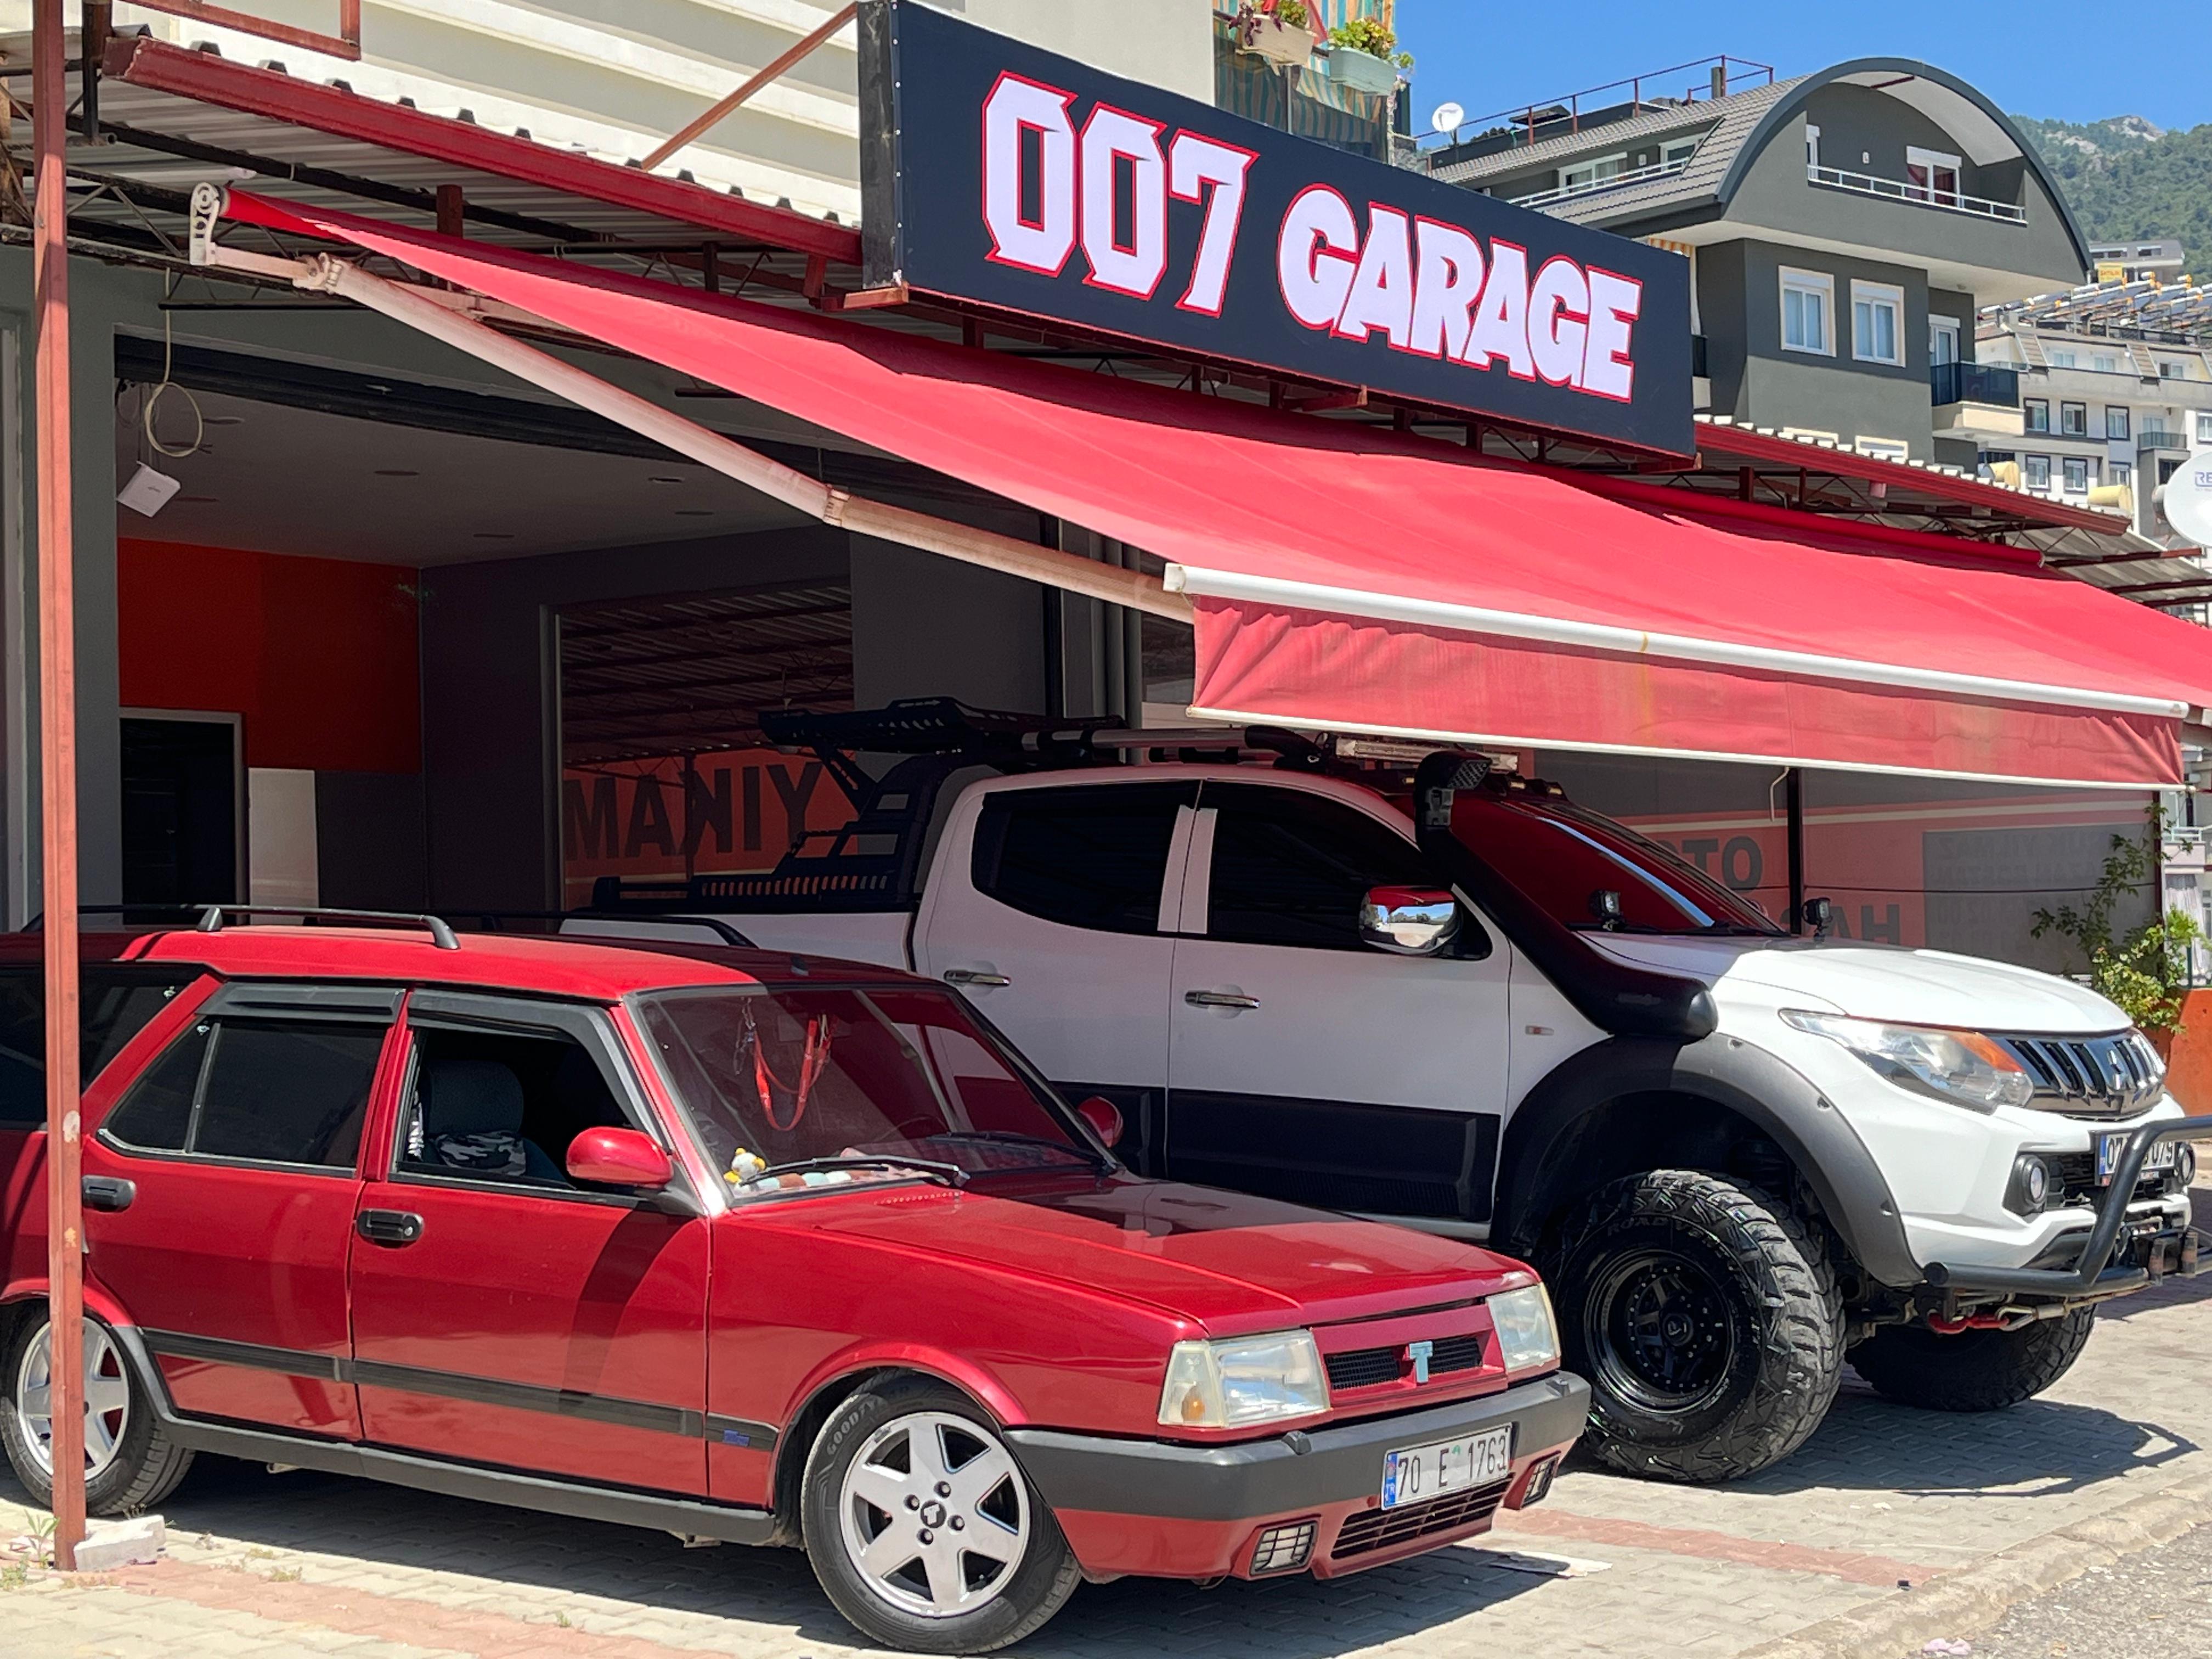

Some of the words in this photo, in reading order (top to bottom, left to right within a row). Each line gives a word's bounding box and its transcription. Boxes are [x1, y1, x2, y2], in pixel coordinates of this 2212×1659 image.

[982, 69, 1260, 318] 007
[1277, 183, 1644, 404] GARAGE
[1398, 1455, 1421, 1498] 70
[1439, 1448, 1449, 1488] E
[1468, 1435, 1506, 1480] 1763
